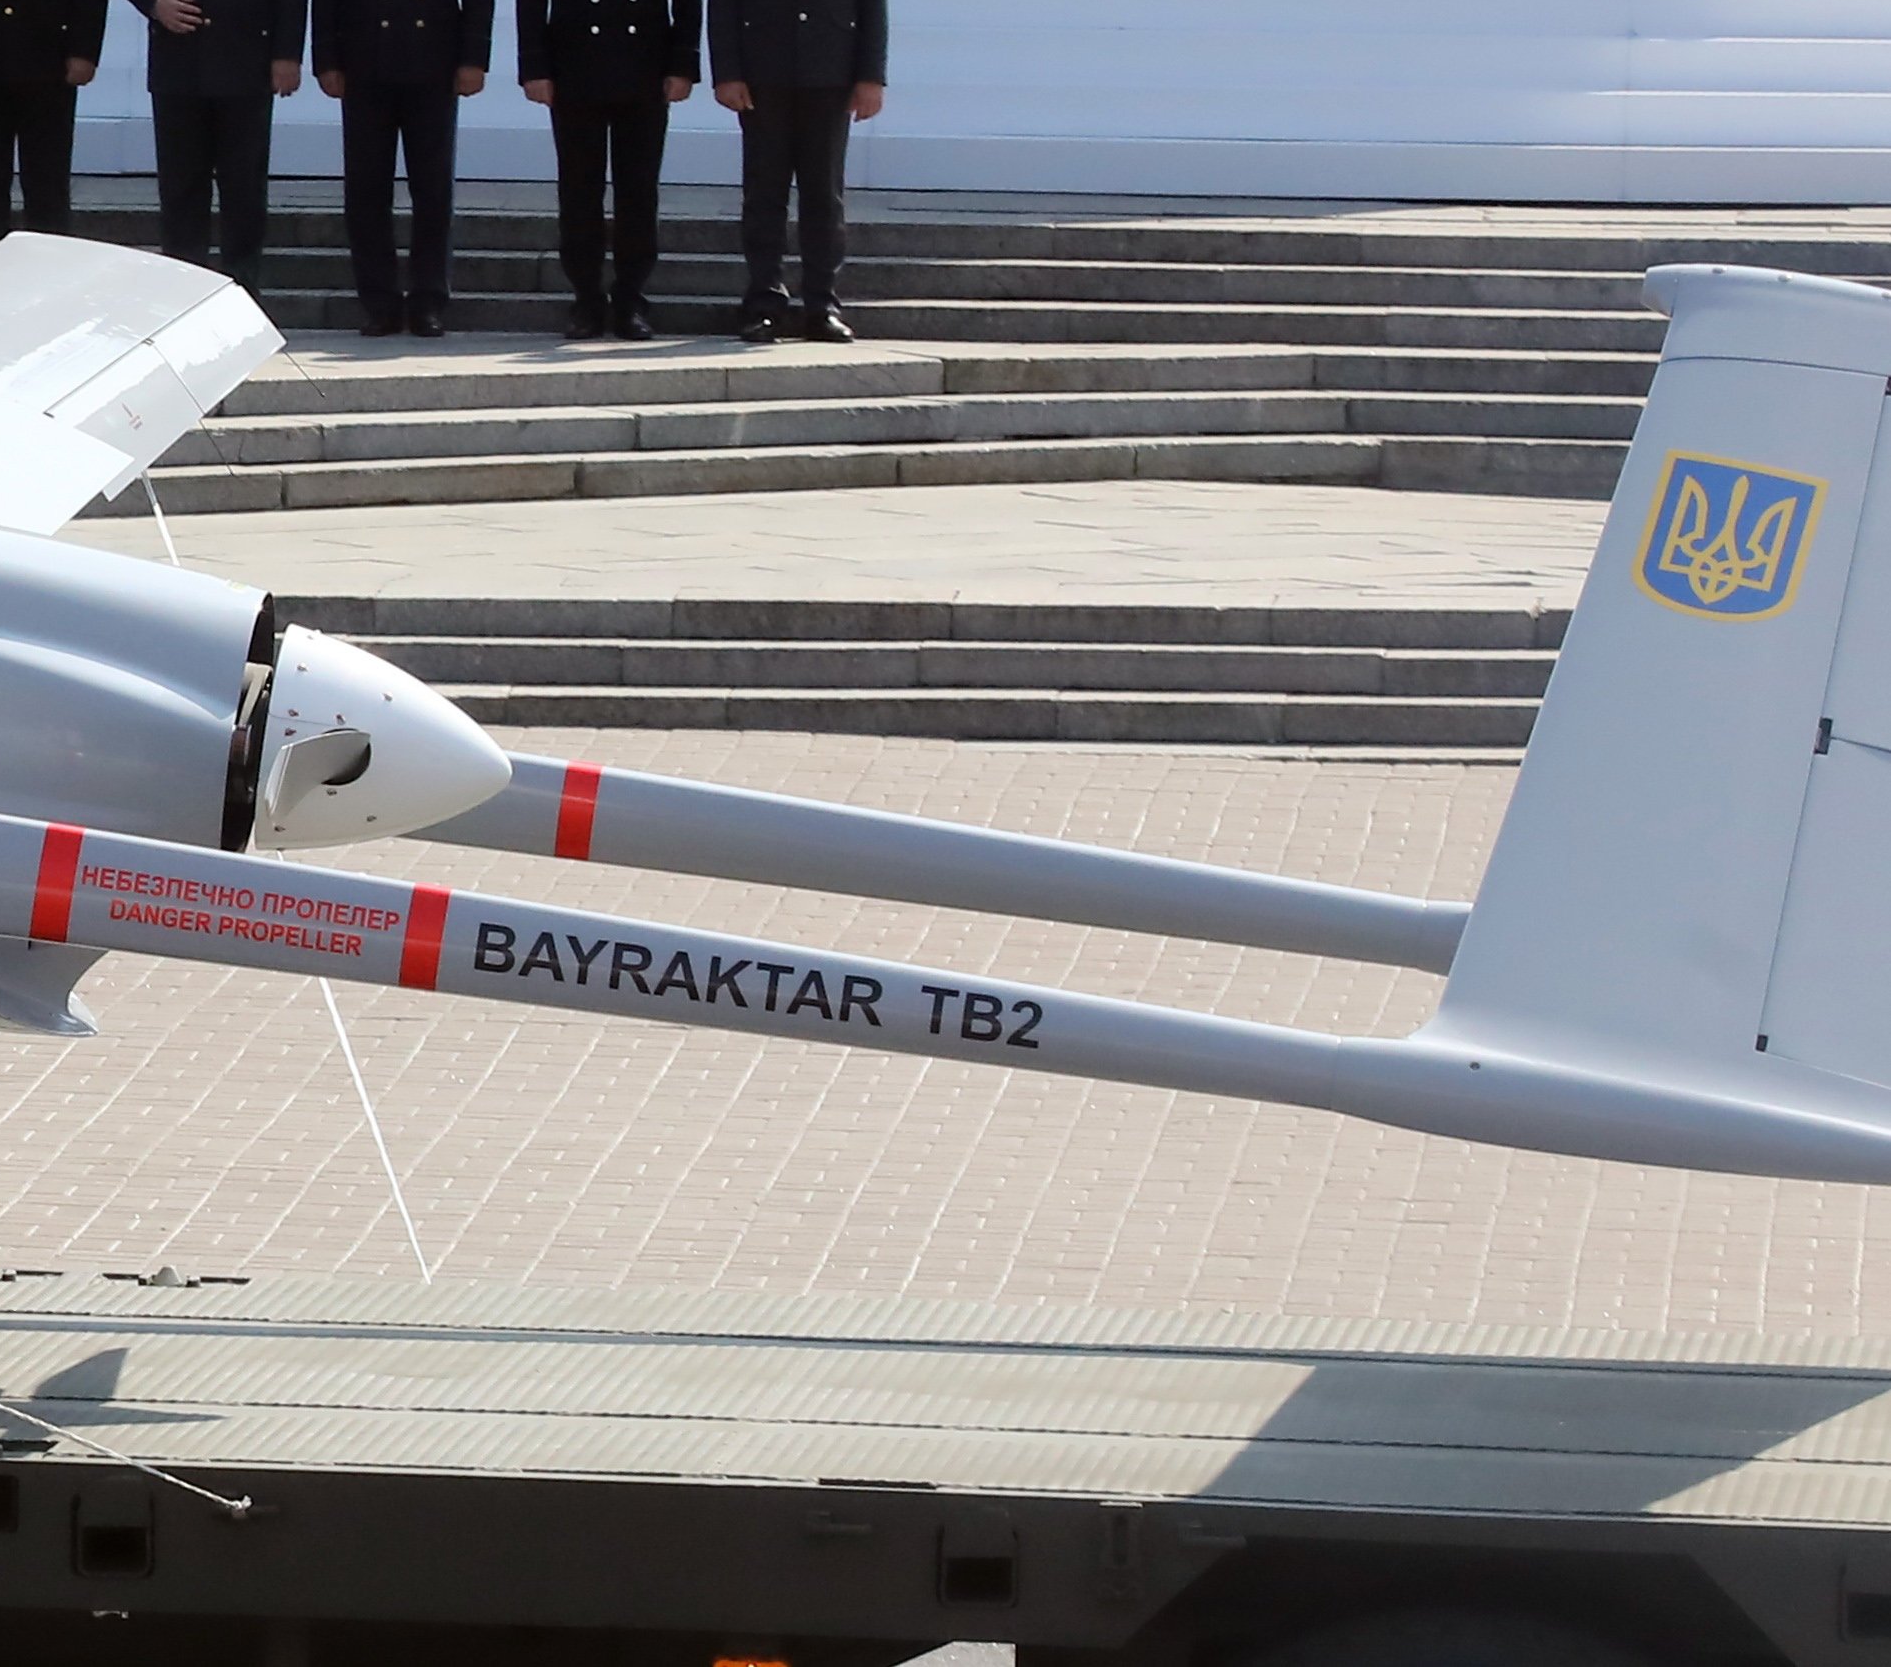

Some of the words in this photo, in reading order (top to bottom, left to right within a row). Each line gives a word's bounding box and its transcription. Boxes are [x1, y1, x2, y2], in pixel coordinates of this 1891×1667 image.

[81, 864, 255, 910] НЕБЕЗПЕЧНО
[261, 892, 401, 933] ПРОПЕЛЕР
[109, 898, 212, 934] DANGER
[217, 915, 363, 957] PROPELLER
[472, 921, 884, 1027] BAYRAKTAR
[920, 984, 1044, 1050] TB2
